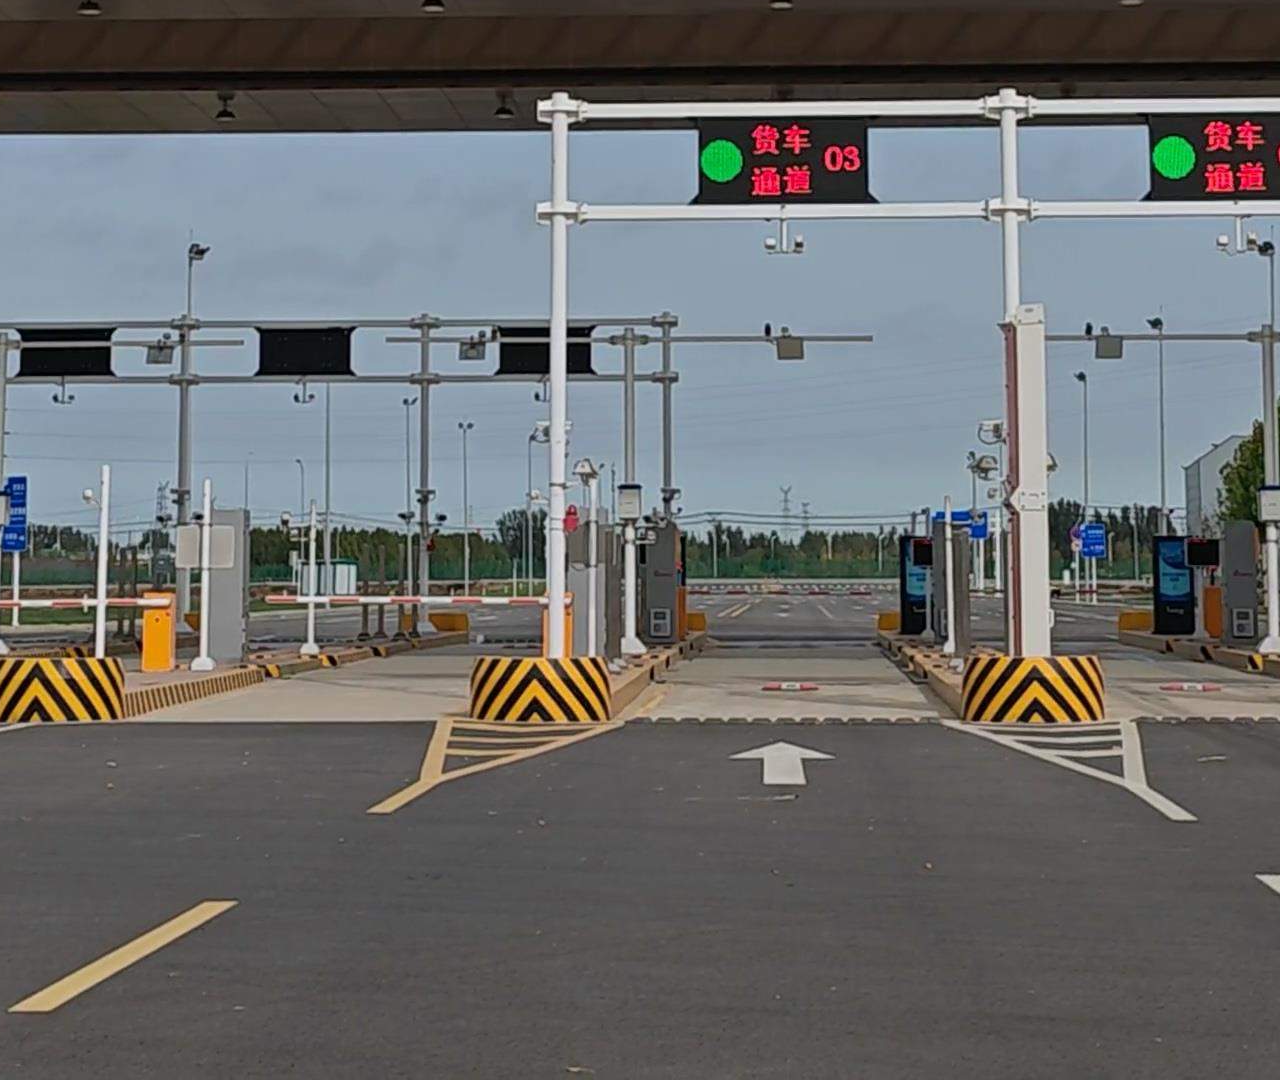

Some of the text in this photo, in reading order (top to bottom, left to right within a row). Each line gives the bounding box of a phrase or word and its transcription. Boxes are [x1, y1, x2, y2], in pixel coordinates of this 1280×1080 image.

[751, 124, 812, 155] 货车
[1204, 121, 1265, 152] 货车
[824, 146, 861, 171] 03
[751, 165, 812, 196] 通道
[1205, 162, 1267, 192] 通道
